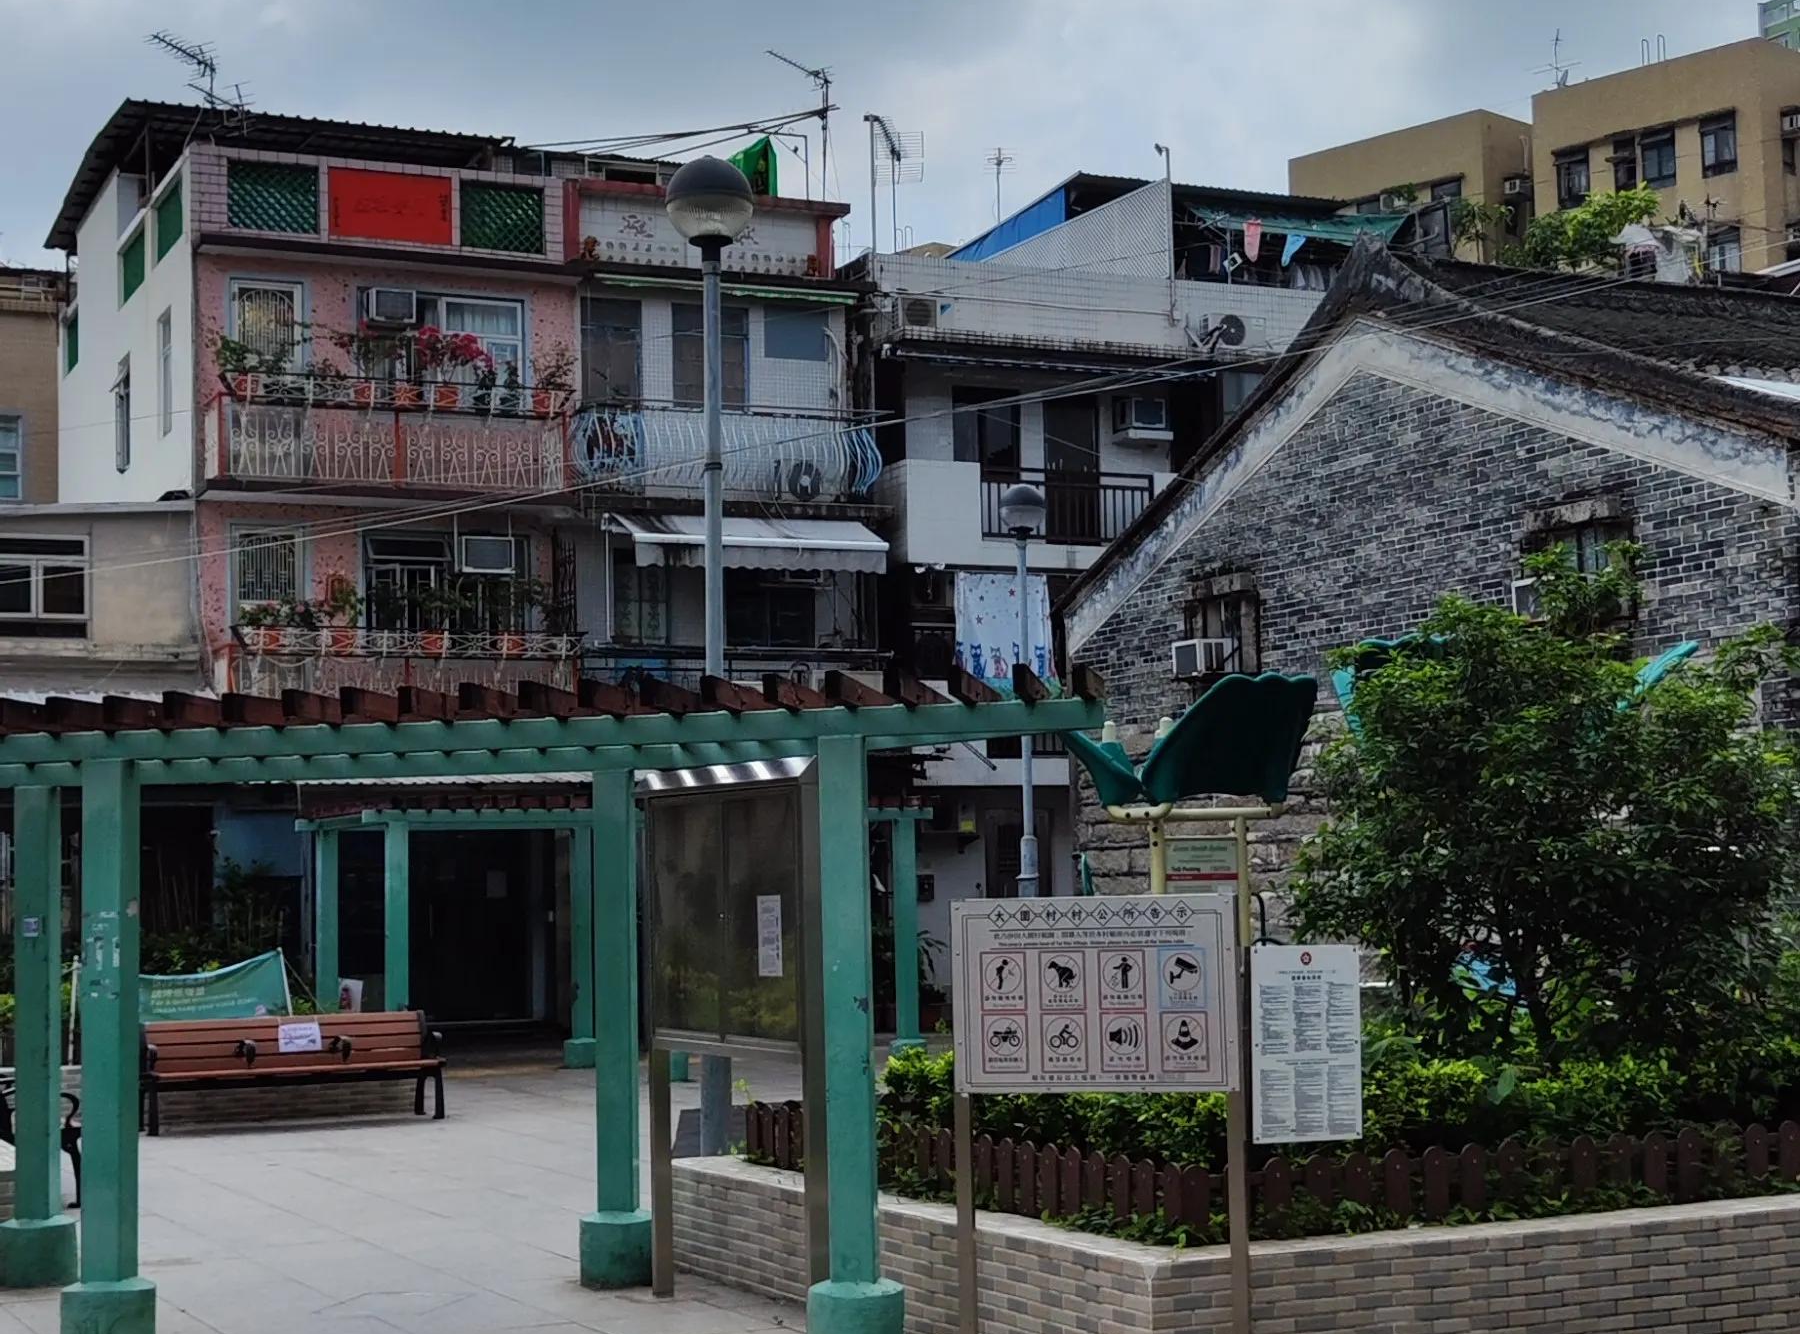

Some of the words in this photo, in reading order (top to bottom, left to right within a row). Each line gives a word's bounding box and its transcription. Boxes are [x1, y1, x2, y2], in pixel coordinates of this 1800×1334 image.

[994, 906, 1187, 923] 大圍村村公所告示
